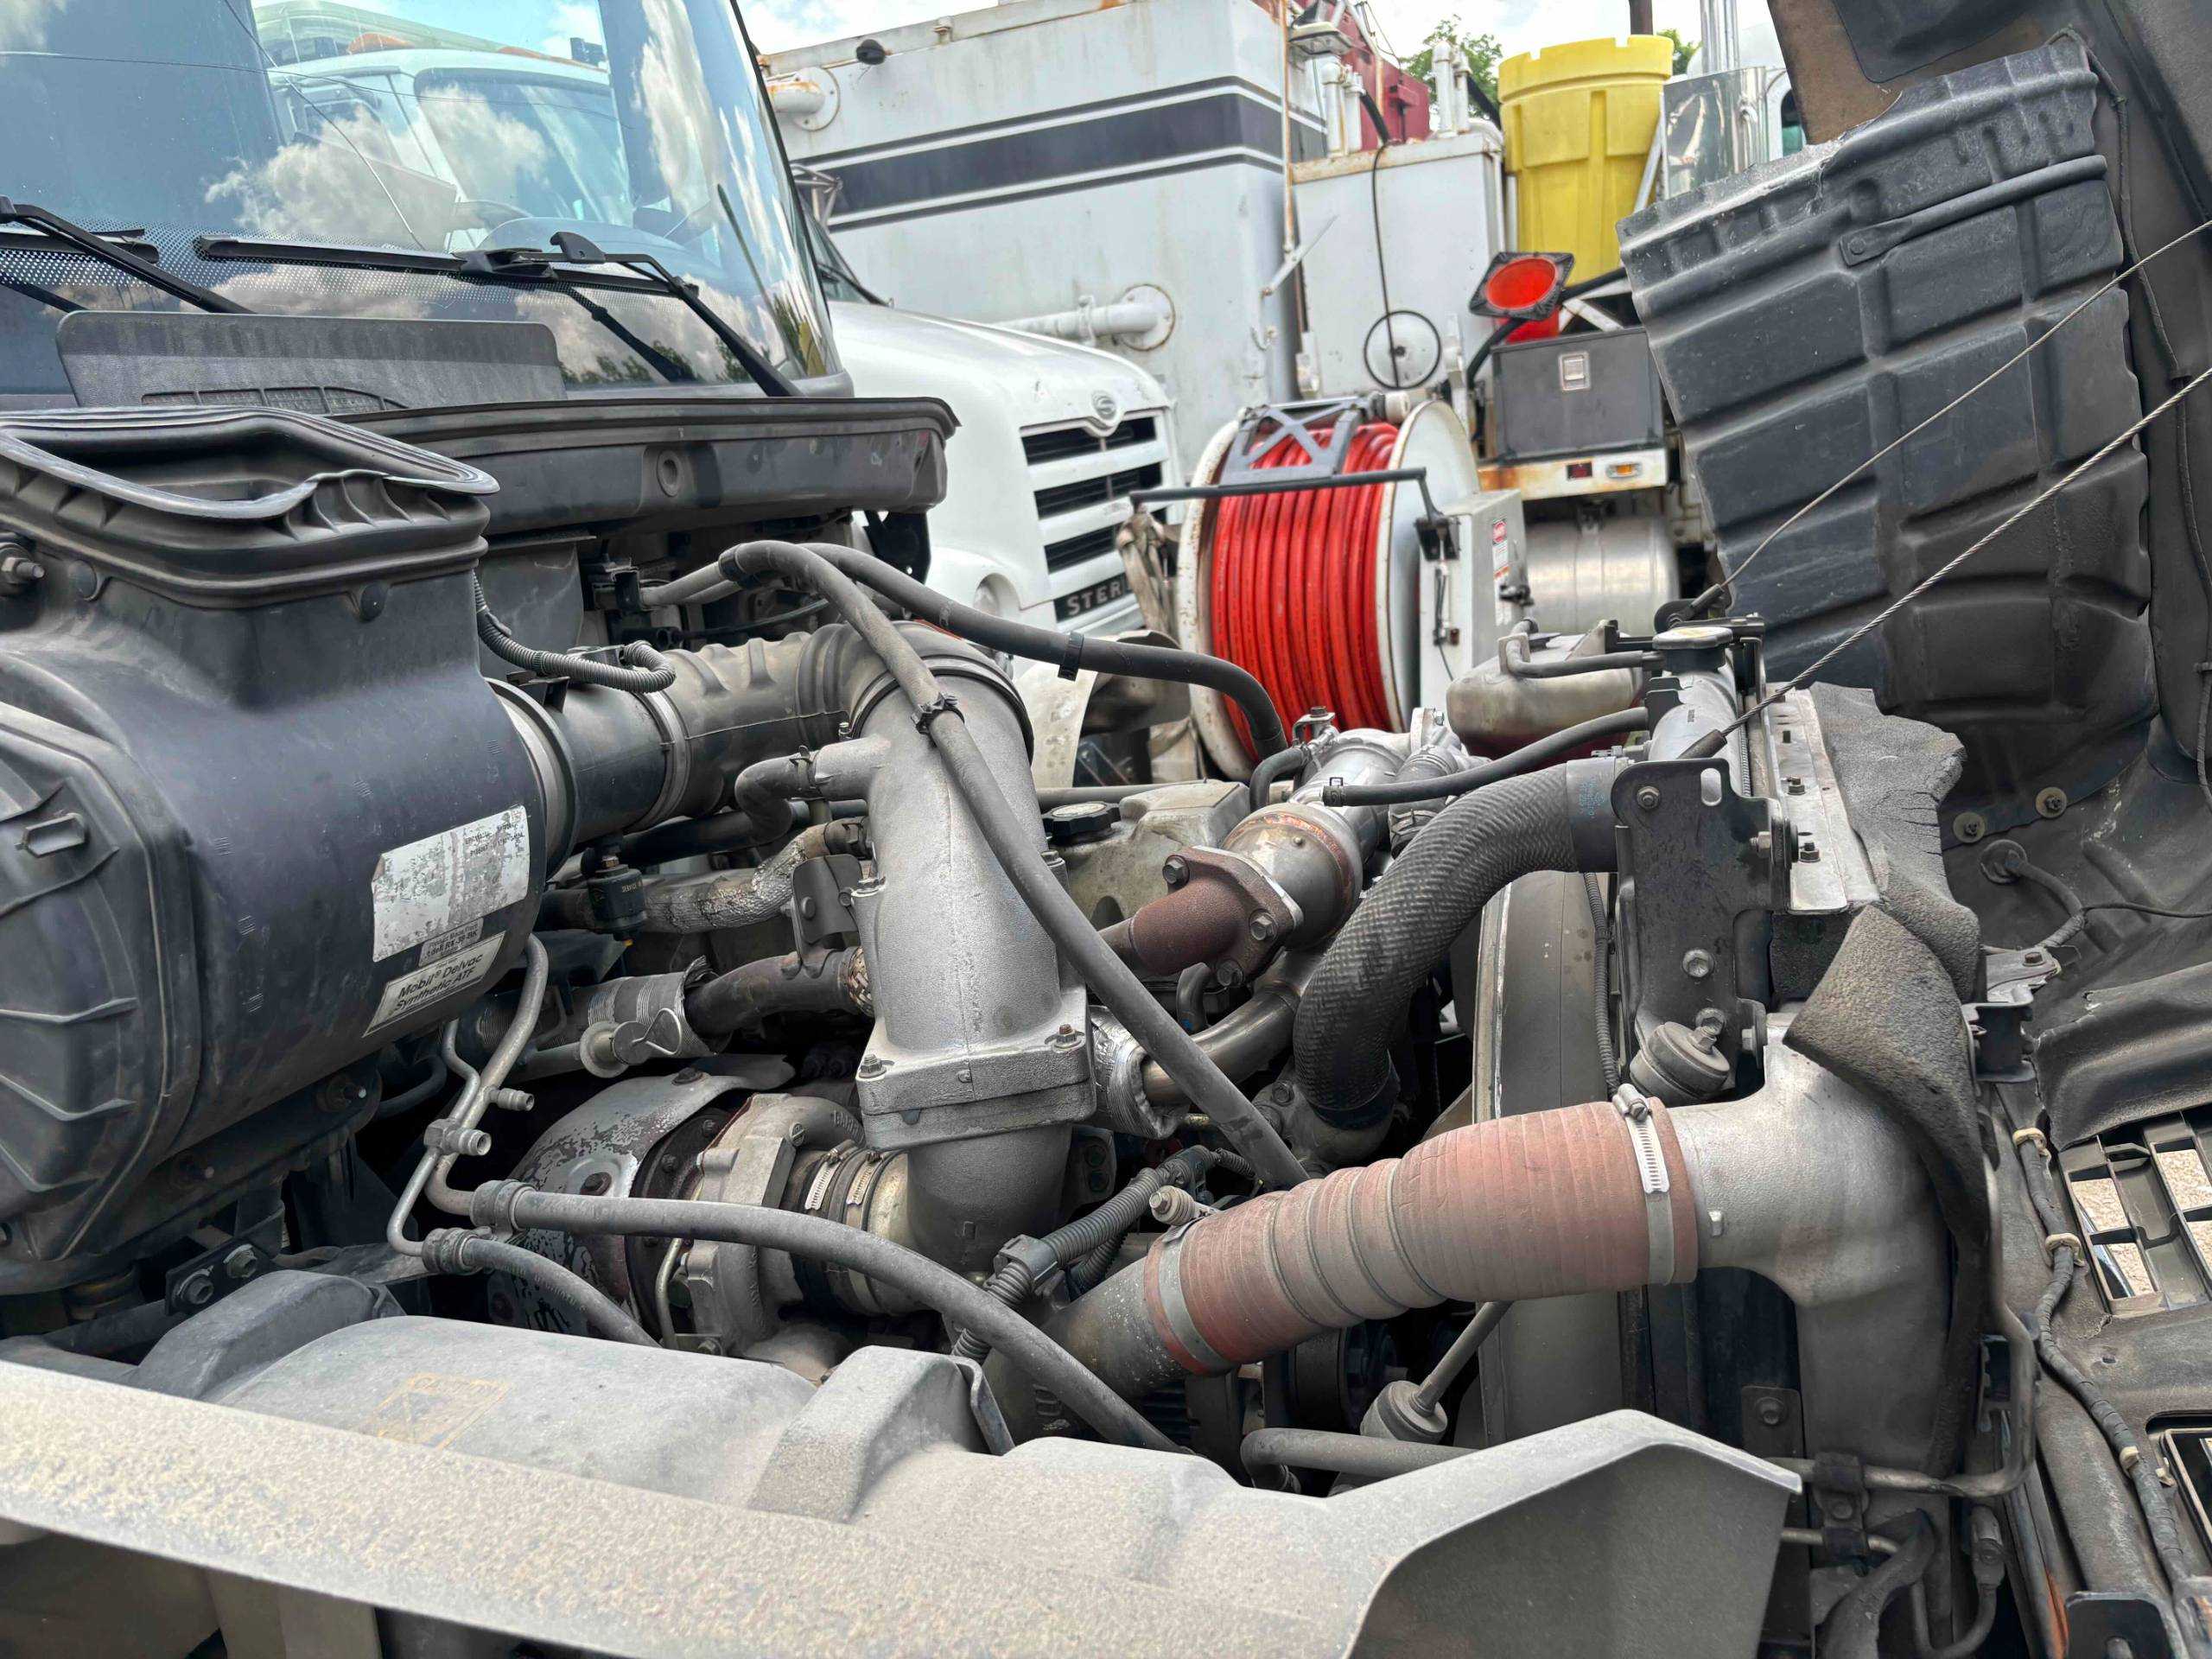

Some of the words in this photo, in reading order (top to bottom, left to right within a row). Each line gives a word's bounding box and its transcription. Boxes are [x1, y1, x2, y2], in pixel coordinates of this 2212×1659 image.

[442, 955, 483, 977] Delvac
[397, 981, 451, 1009] Synthetic
[453, 966, 476, 982] ATF
